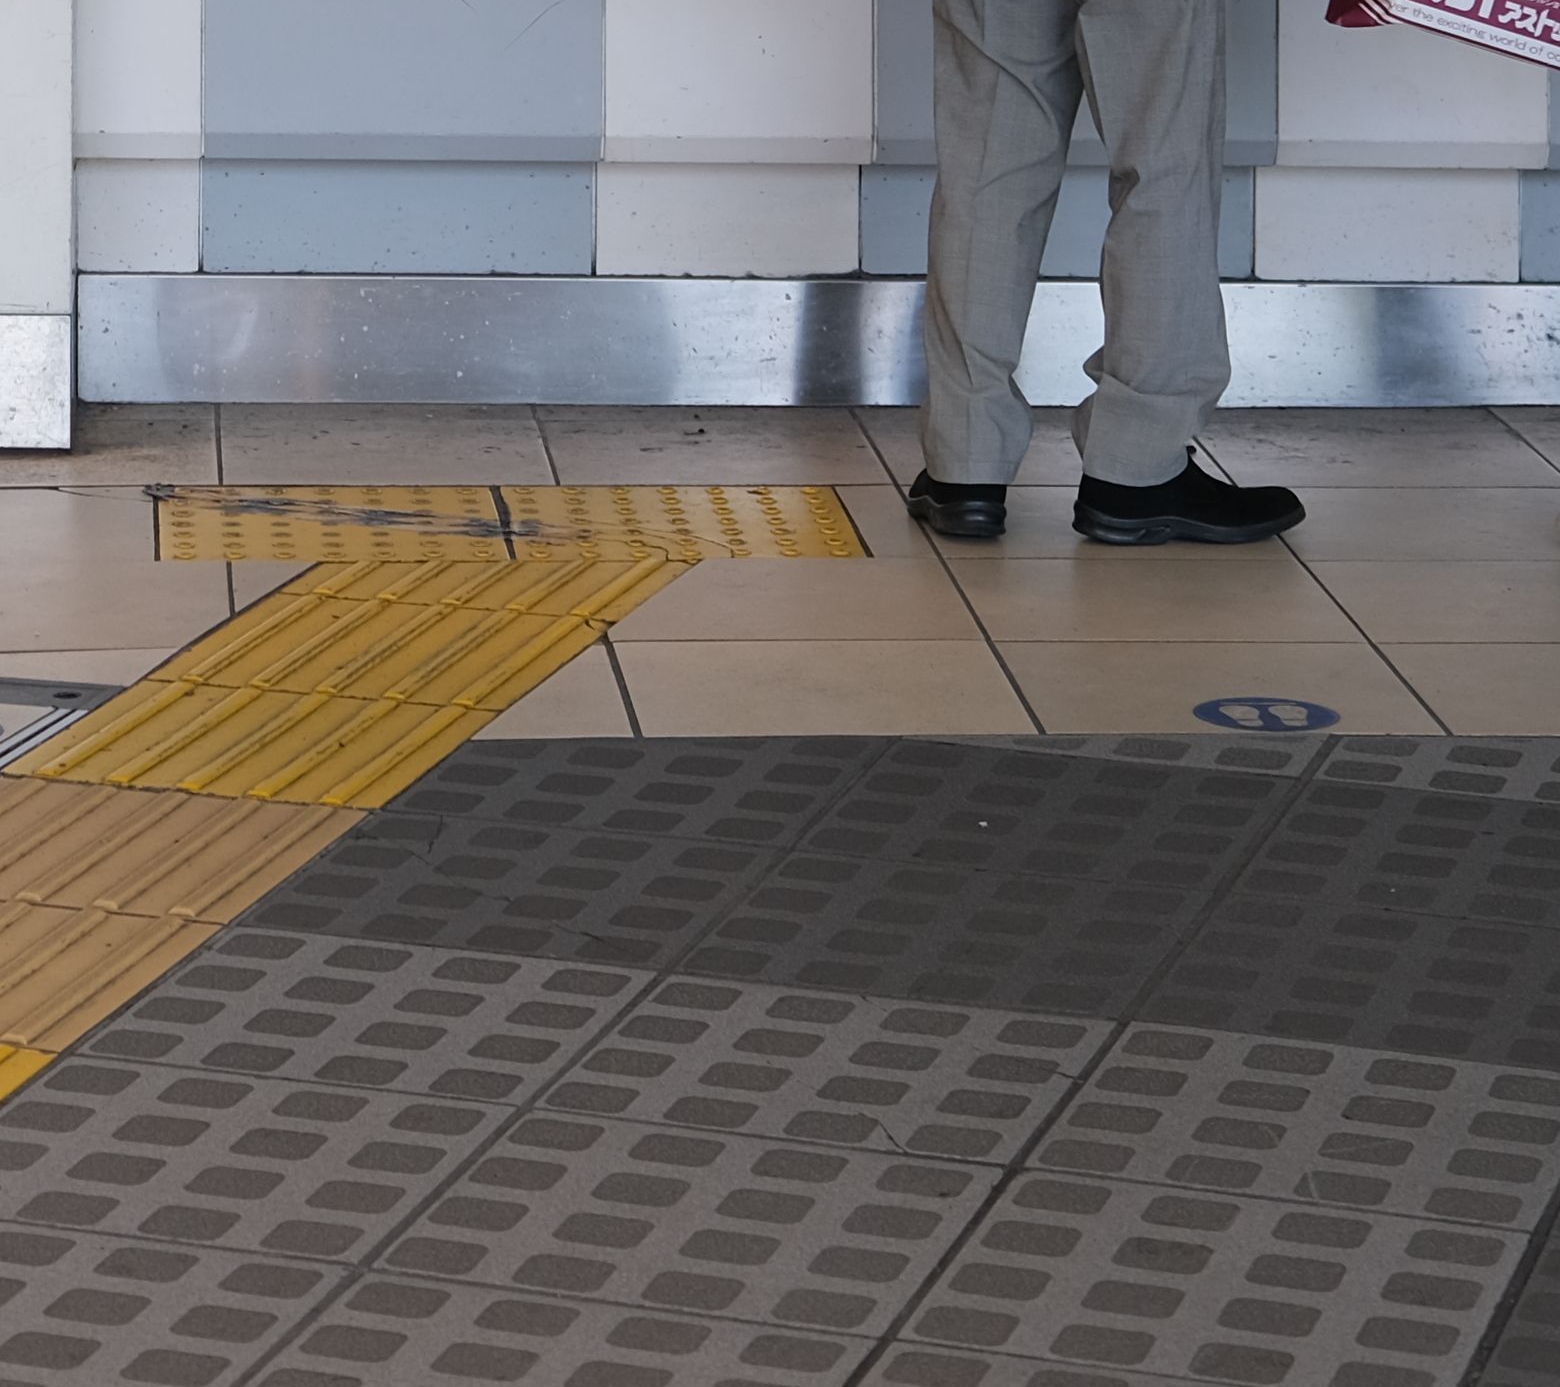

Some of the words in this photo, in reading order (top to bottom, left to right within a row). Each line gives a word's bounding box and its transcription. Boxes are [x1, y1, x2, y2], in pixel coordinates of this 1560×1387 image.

[1413, 7, 1434, 22] the
[1437, 15, 1486, 39] exciting
[1490, 32, 1526, 51] world
